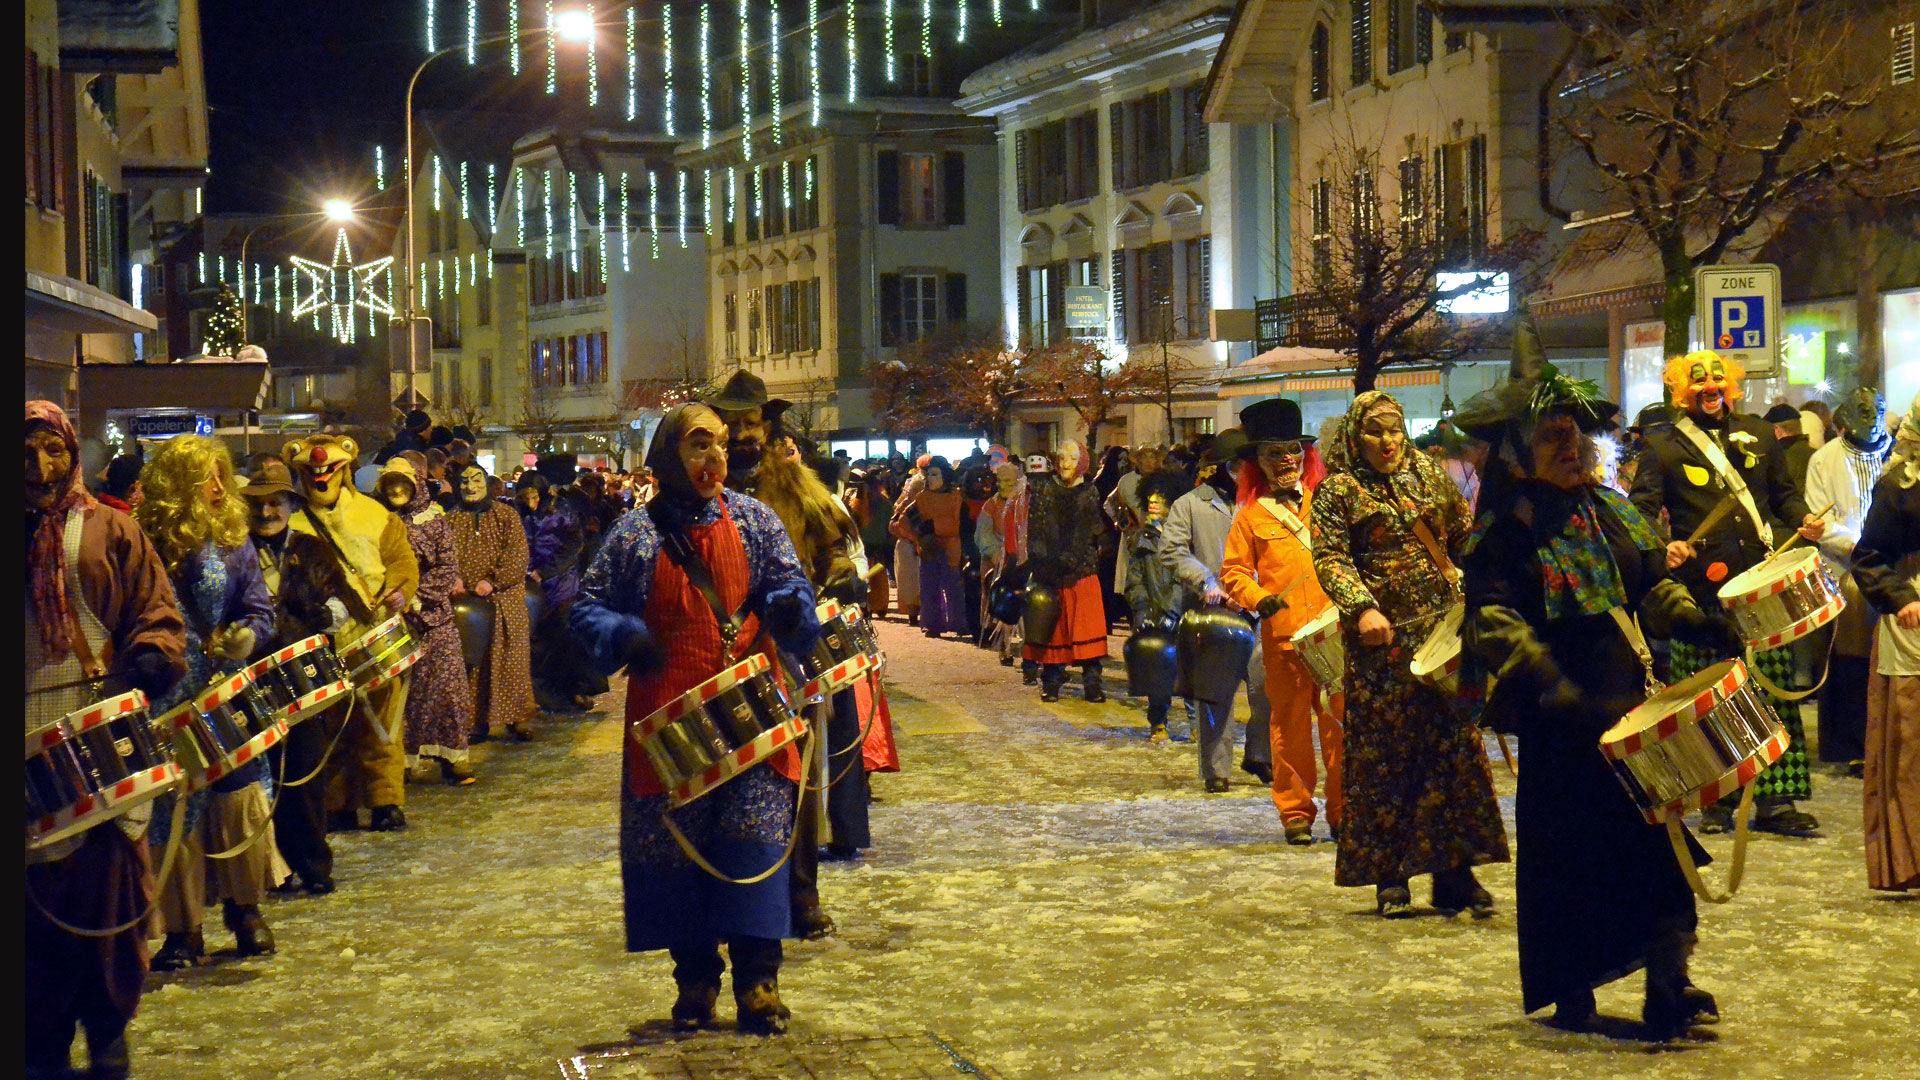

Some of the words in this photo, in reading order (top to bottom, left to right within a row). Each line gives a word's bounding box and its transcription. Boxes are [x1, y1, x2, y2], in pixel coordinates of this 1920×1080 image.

[1721, 277, 1755, 290] ZONE
[1721, 300, 1748, 337] P
[129, 418, 194, 434] Papeterie
